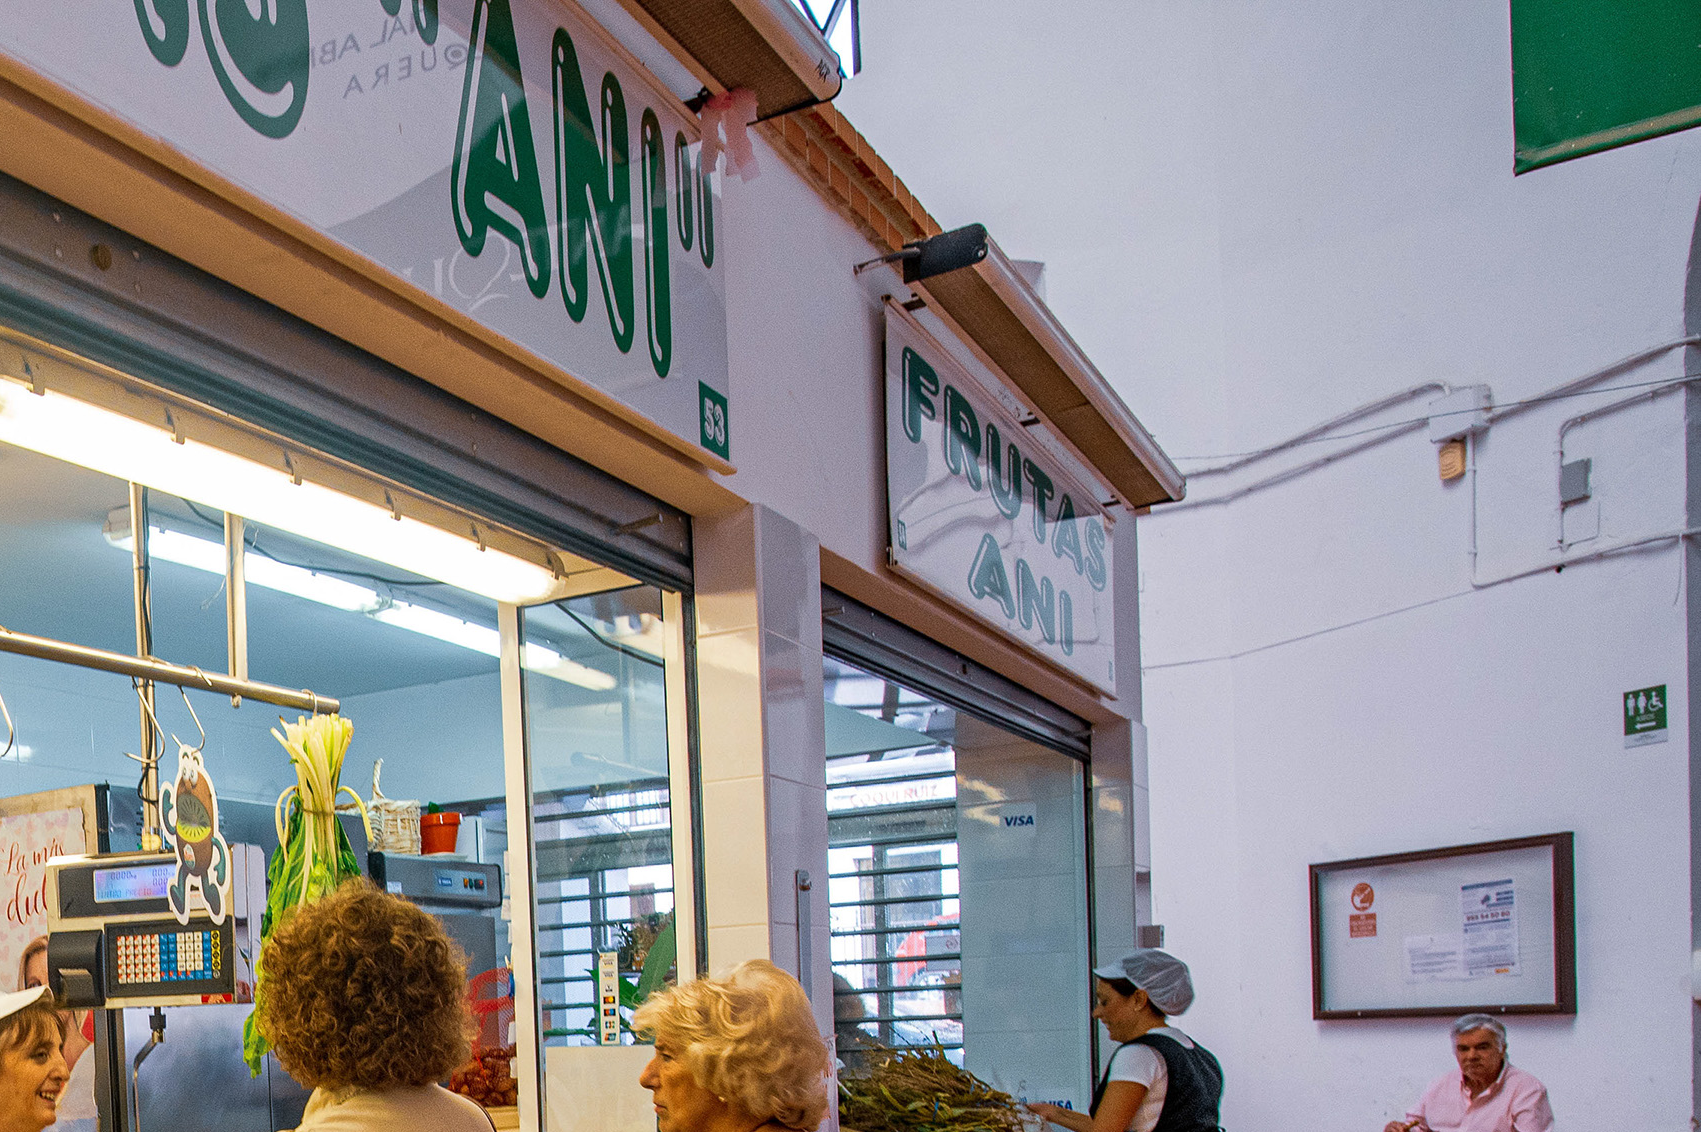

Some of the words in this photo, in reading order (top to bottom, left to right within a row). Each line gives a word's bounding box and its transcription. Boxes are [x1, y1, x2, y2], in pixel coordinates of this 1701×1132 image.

[704, 397, 725, 449] 53
[901, 345, 1107, 592] FRUTAS
[967, 532, 1074, 657] ANI
[1005, 814, 1035, 828] VISA
